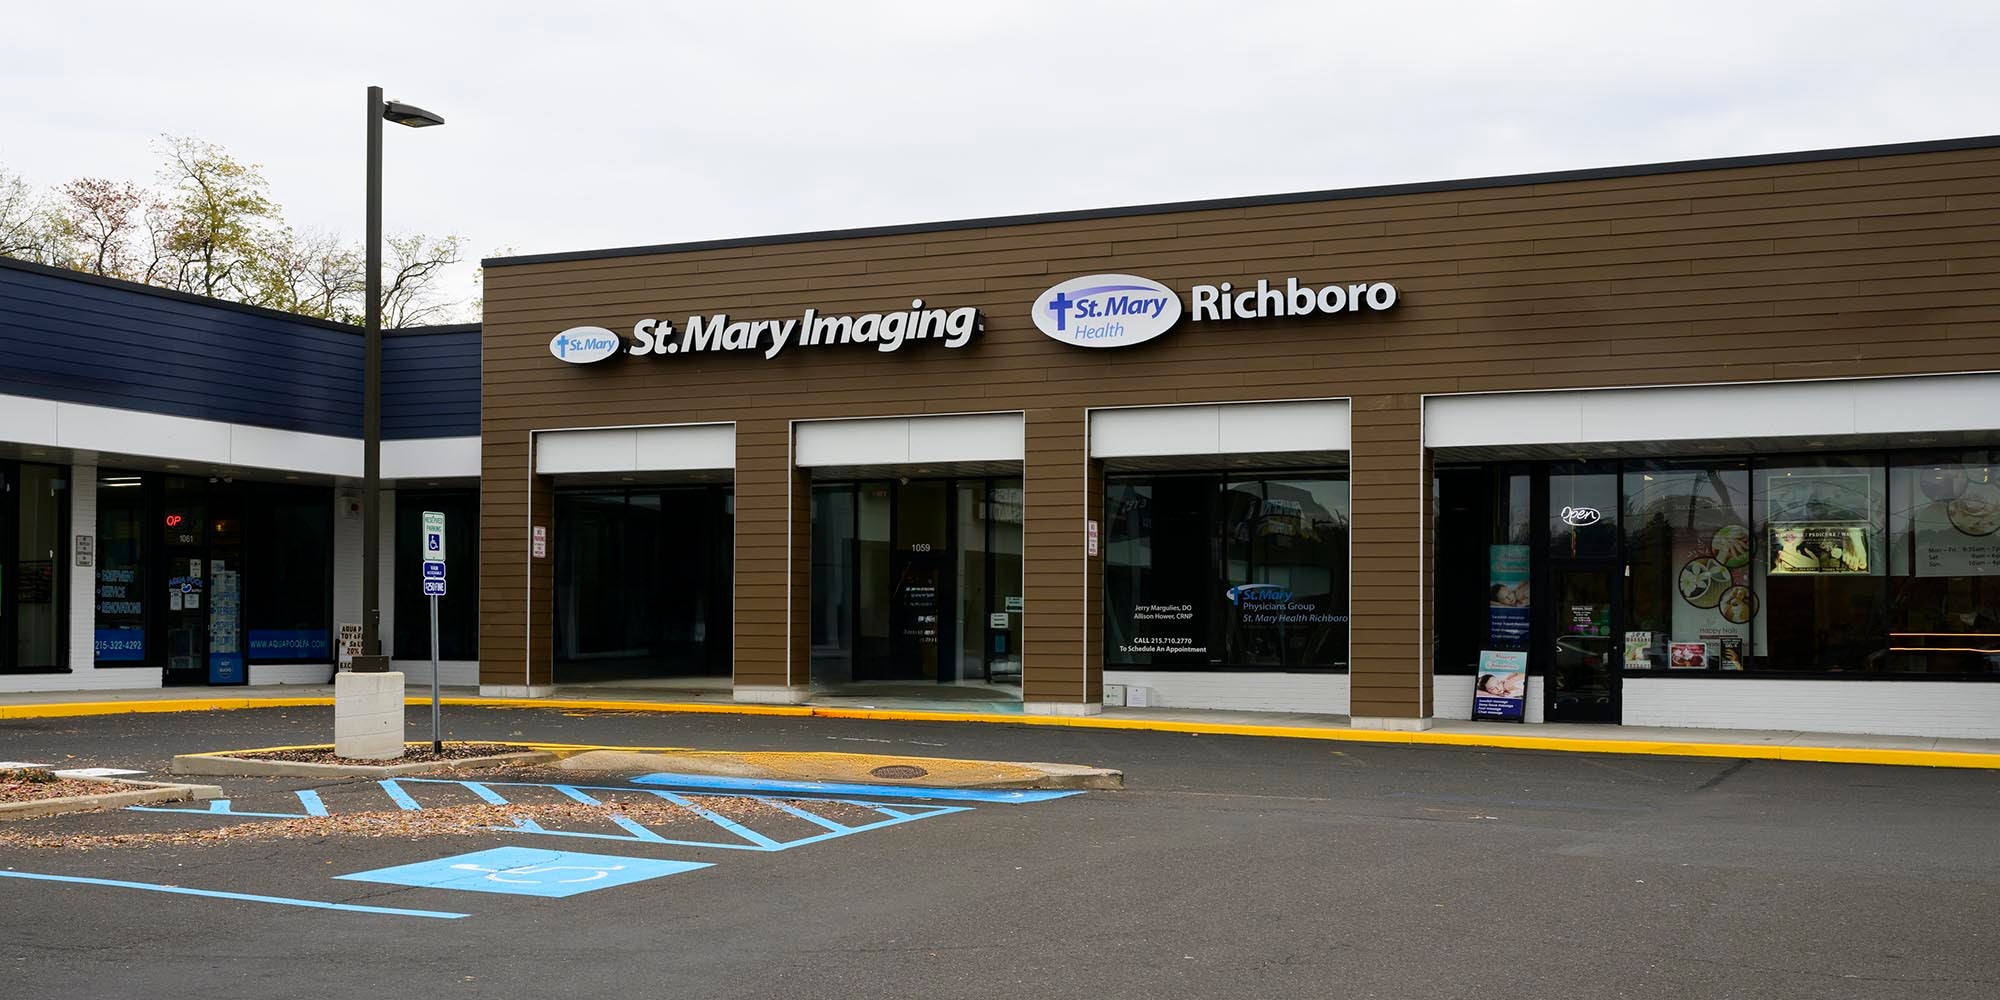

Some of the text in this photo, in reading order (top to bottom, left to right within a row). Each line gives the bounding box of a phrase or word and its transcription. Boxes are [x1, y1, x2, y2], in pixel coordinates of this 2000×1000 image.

[1191, 277, 1397, 322] Richboro
[1103, 294, 1168, 320] Mary
[681, 313, 798, 360] Mary
[799, 297, 978, 353] Imaging
[1074, 322, 1124, 340] Health
[1561, 506, 1597, 524] Open
[179, 535, 194, 543] 1061
[912, 543, 931, 552] 1059
[168, 575, 186, 587] AQUA
[1242, 589, 1293, 602] St. Mary
[1134, 604, 1150, 613] Jerry
[1150, 604, 1181, 613] Margulies,
[1242, 602, 1316, 612] Physicians Group
[1242, 613, 1349, 624] St. Mary Health Richboro
[95, 640, 143, 650] 215-322-4292
[1150, 637, 1193, 645] 215.710.2770
[1166, 645, 1208, 654] Appointment
